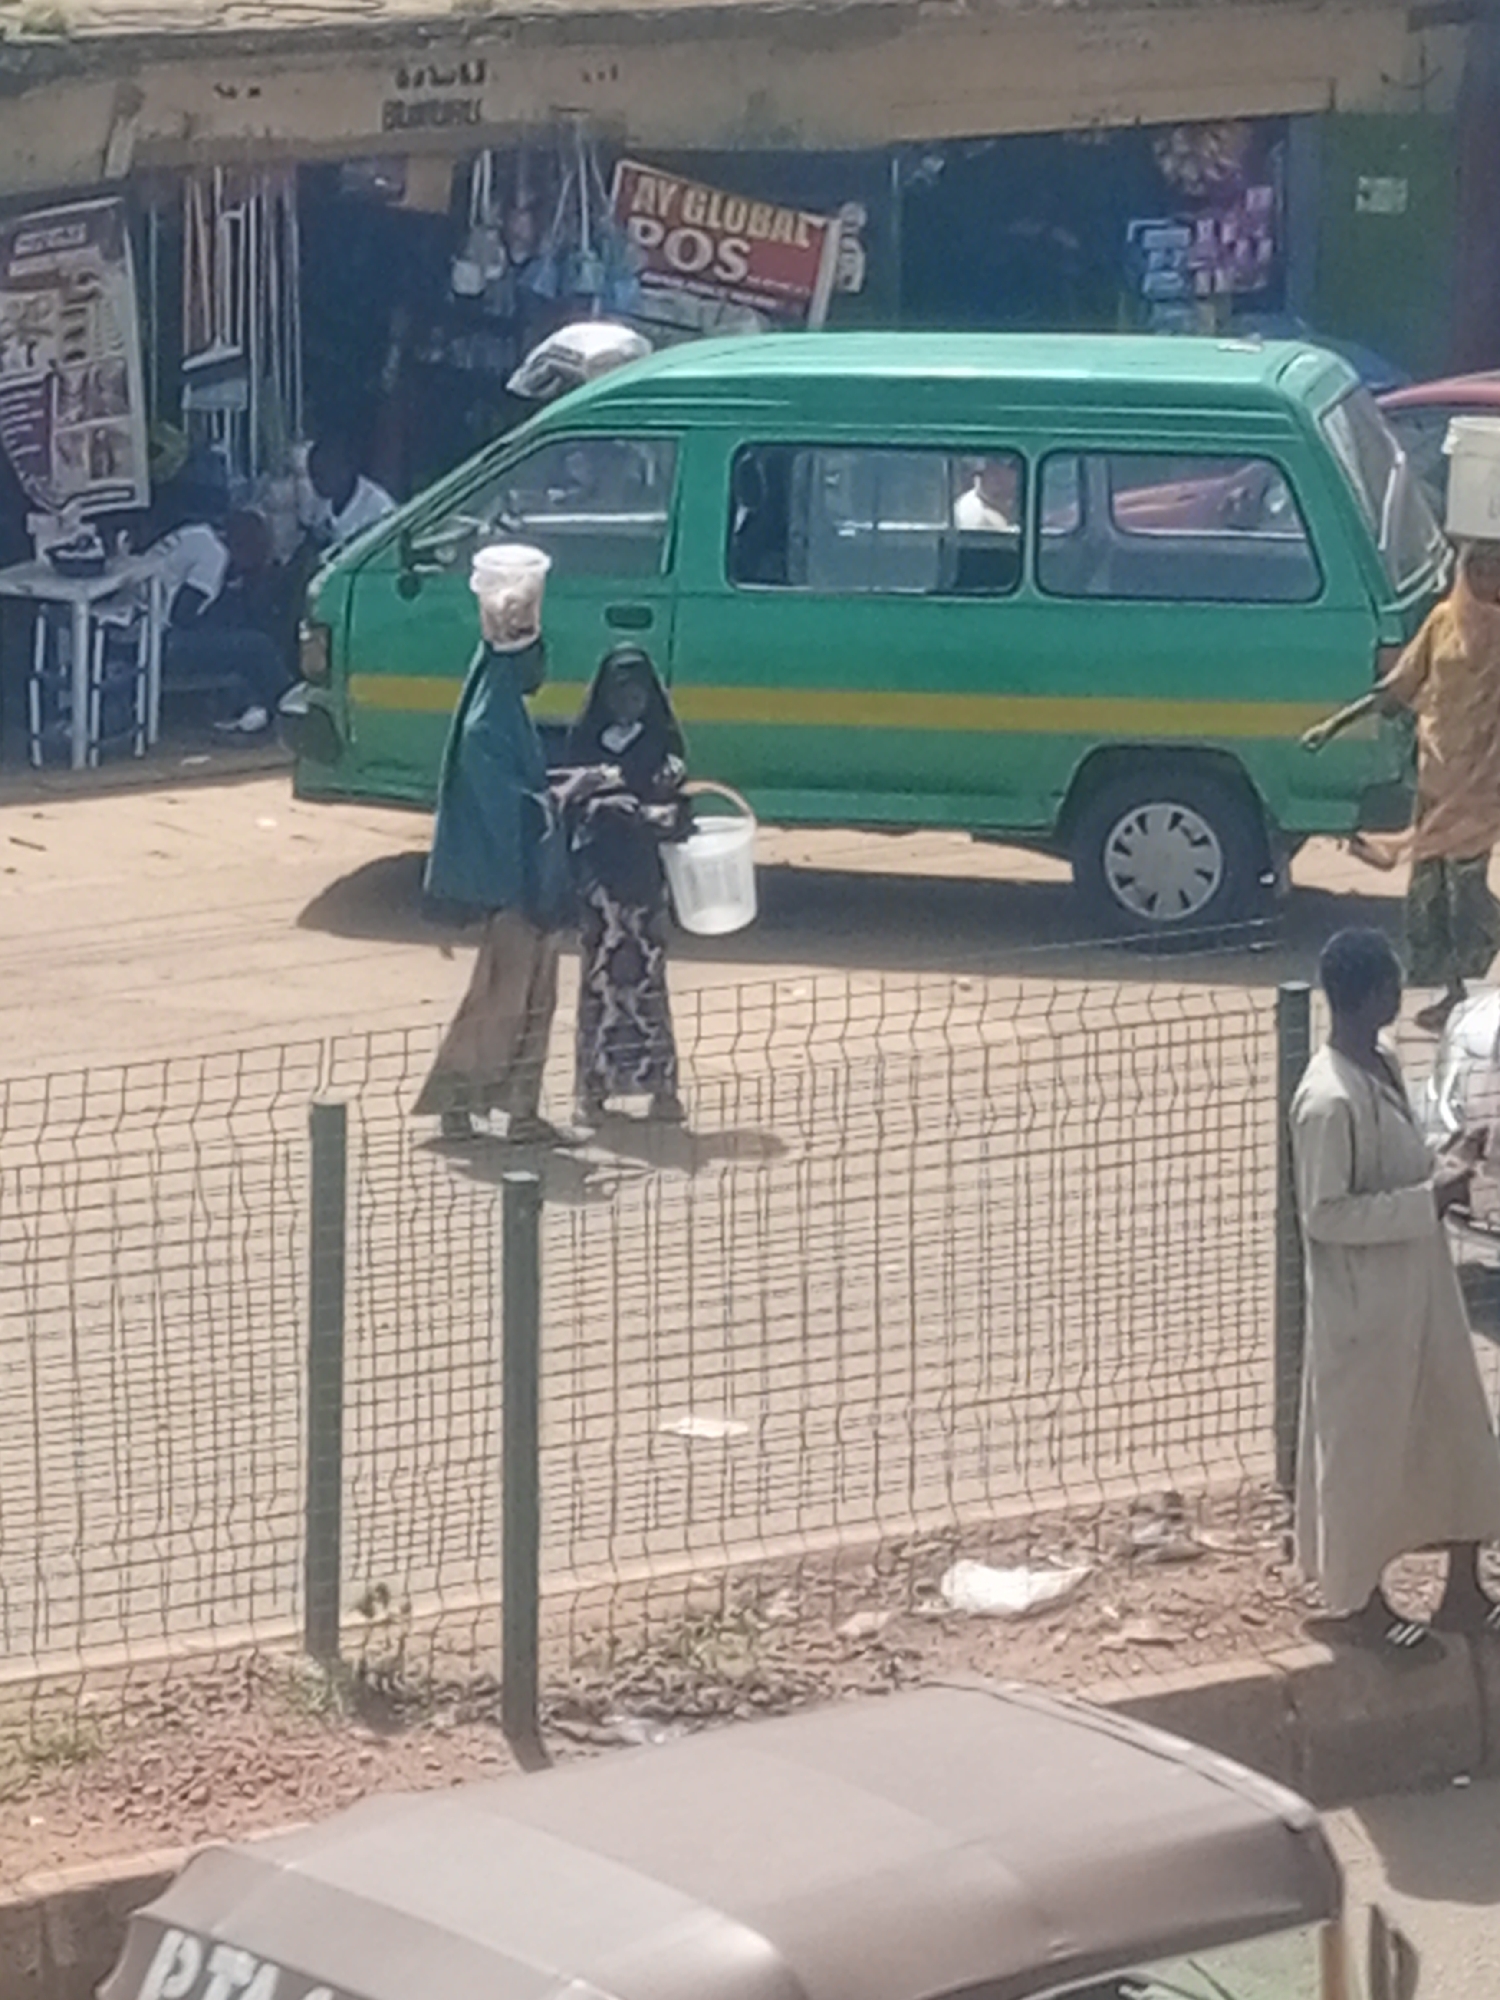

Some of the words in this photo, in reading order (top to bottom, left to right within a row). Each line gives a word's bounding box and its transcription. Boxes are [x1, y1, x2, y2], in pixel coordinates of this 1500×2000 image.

[632, 175, 677, 217] AY
[680, 187, 809, 248] GLOBAL
[628, 216, 750, 282] POS
